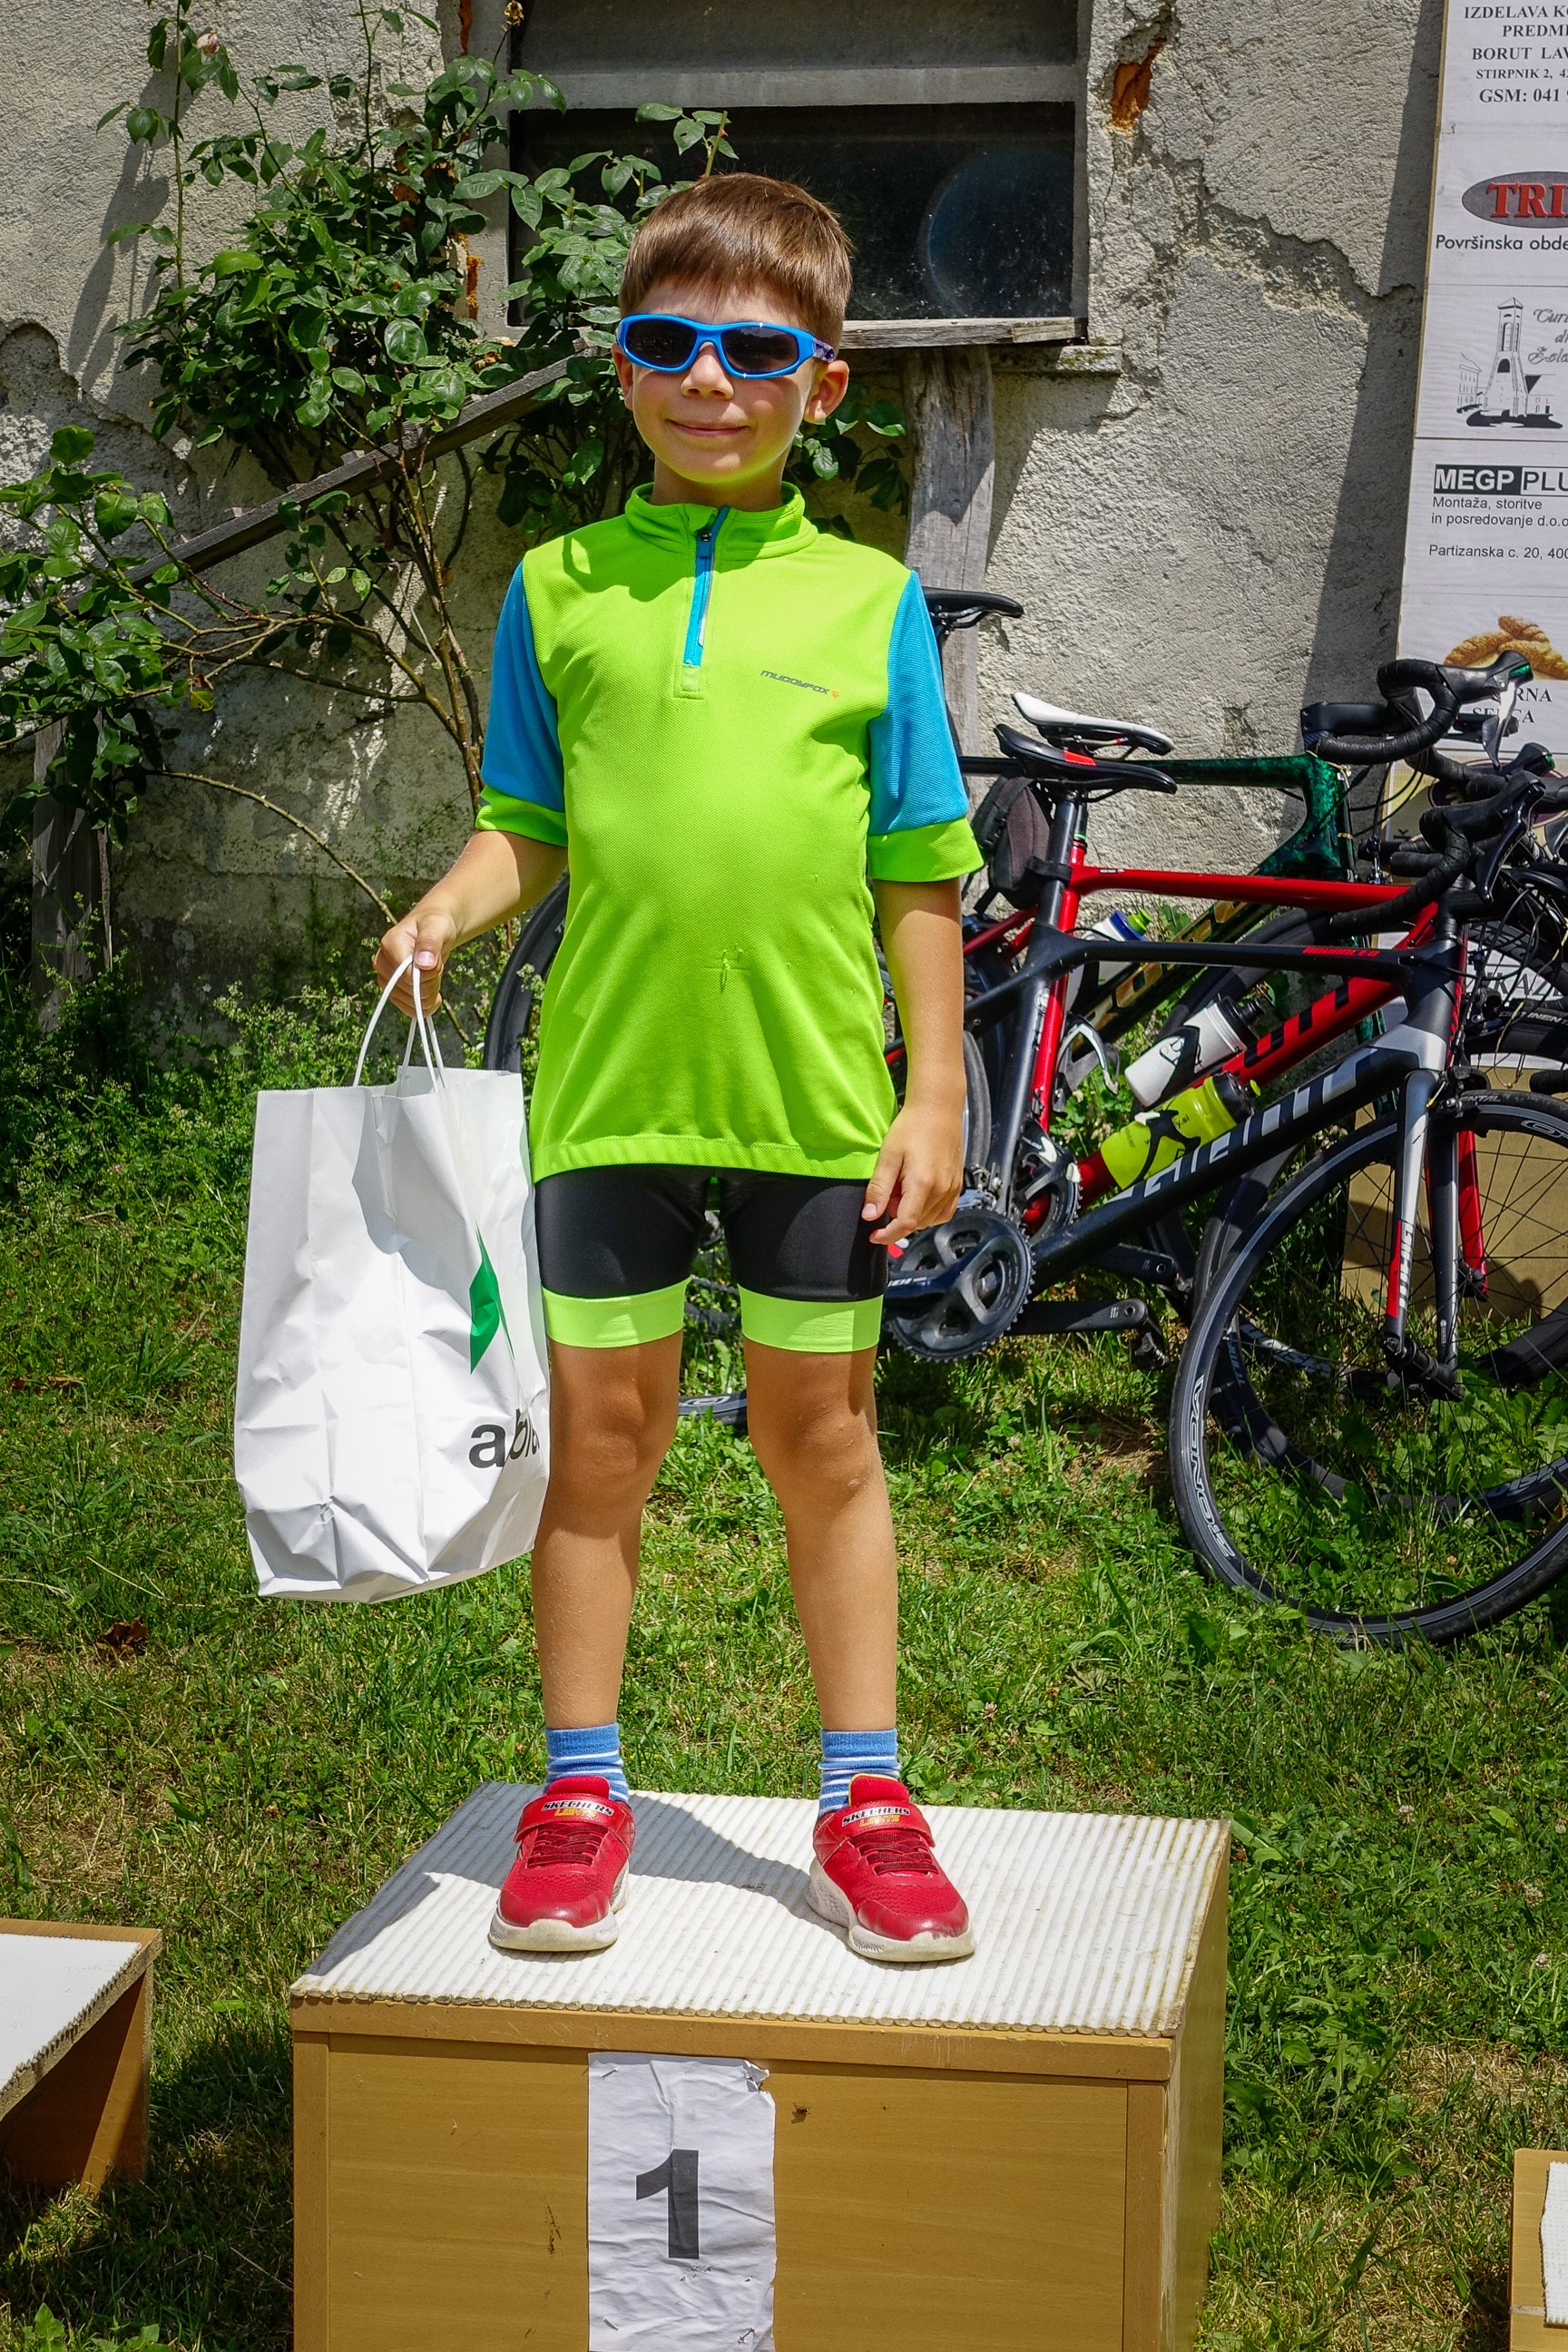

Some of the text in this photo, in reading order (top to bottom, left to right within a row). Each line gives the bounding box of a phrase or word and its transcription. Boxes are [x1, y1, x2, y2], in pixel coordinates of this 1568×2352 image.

[1464, 6, 1548, 18] IZDELAVA
[1472, 47, 1532, 60] BORUT
[1476, 69, 1539, 79] STIRPNIK
[1479, 88, 1560, 103] GSM: 041
[1436, 235, 1523, 250] Površinska
[1435, 469, 1514, 491] MEGP
[1433, 496, 1543, 510] Montaža, storitve
[1432, 514, 1442, 524] in
[1446, 514, 1533, 528] posredovanje
[1429, 544, 1504, 558] Partizanska
[1508, 548, 1519, 558] c.
[1524, 546, 1543, 560] 20,
[636, 2149, 700, 2259] 1
